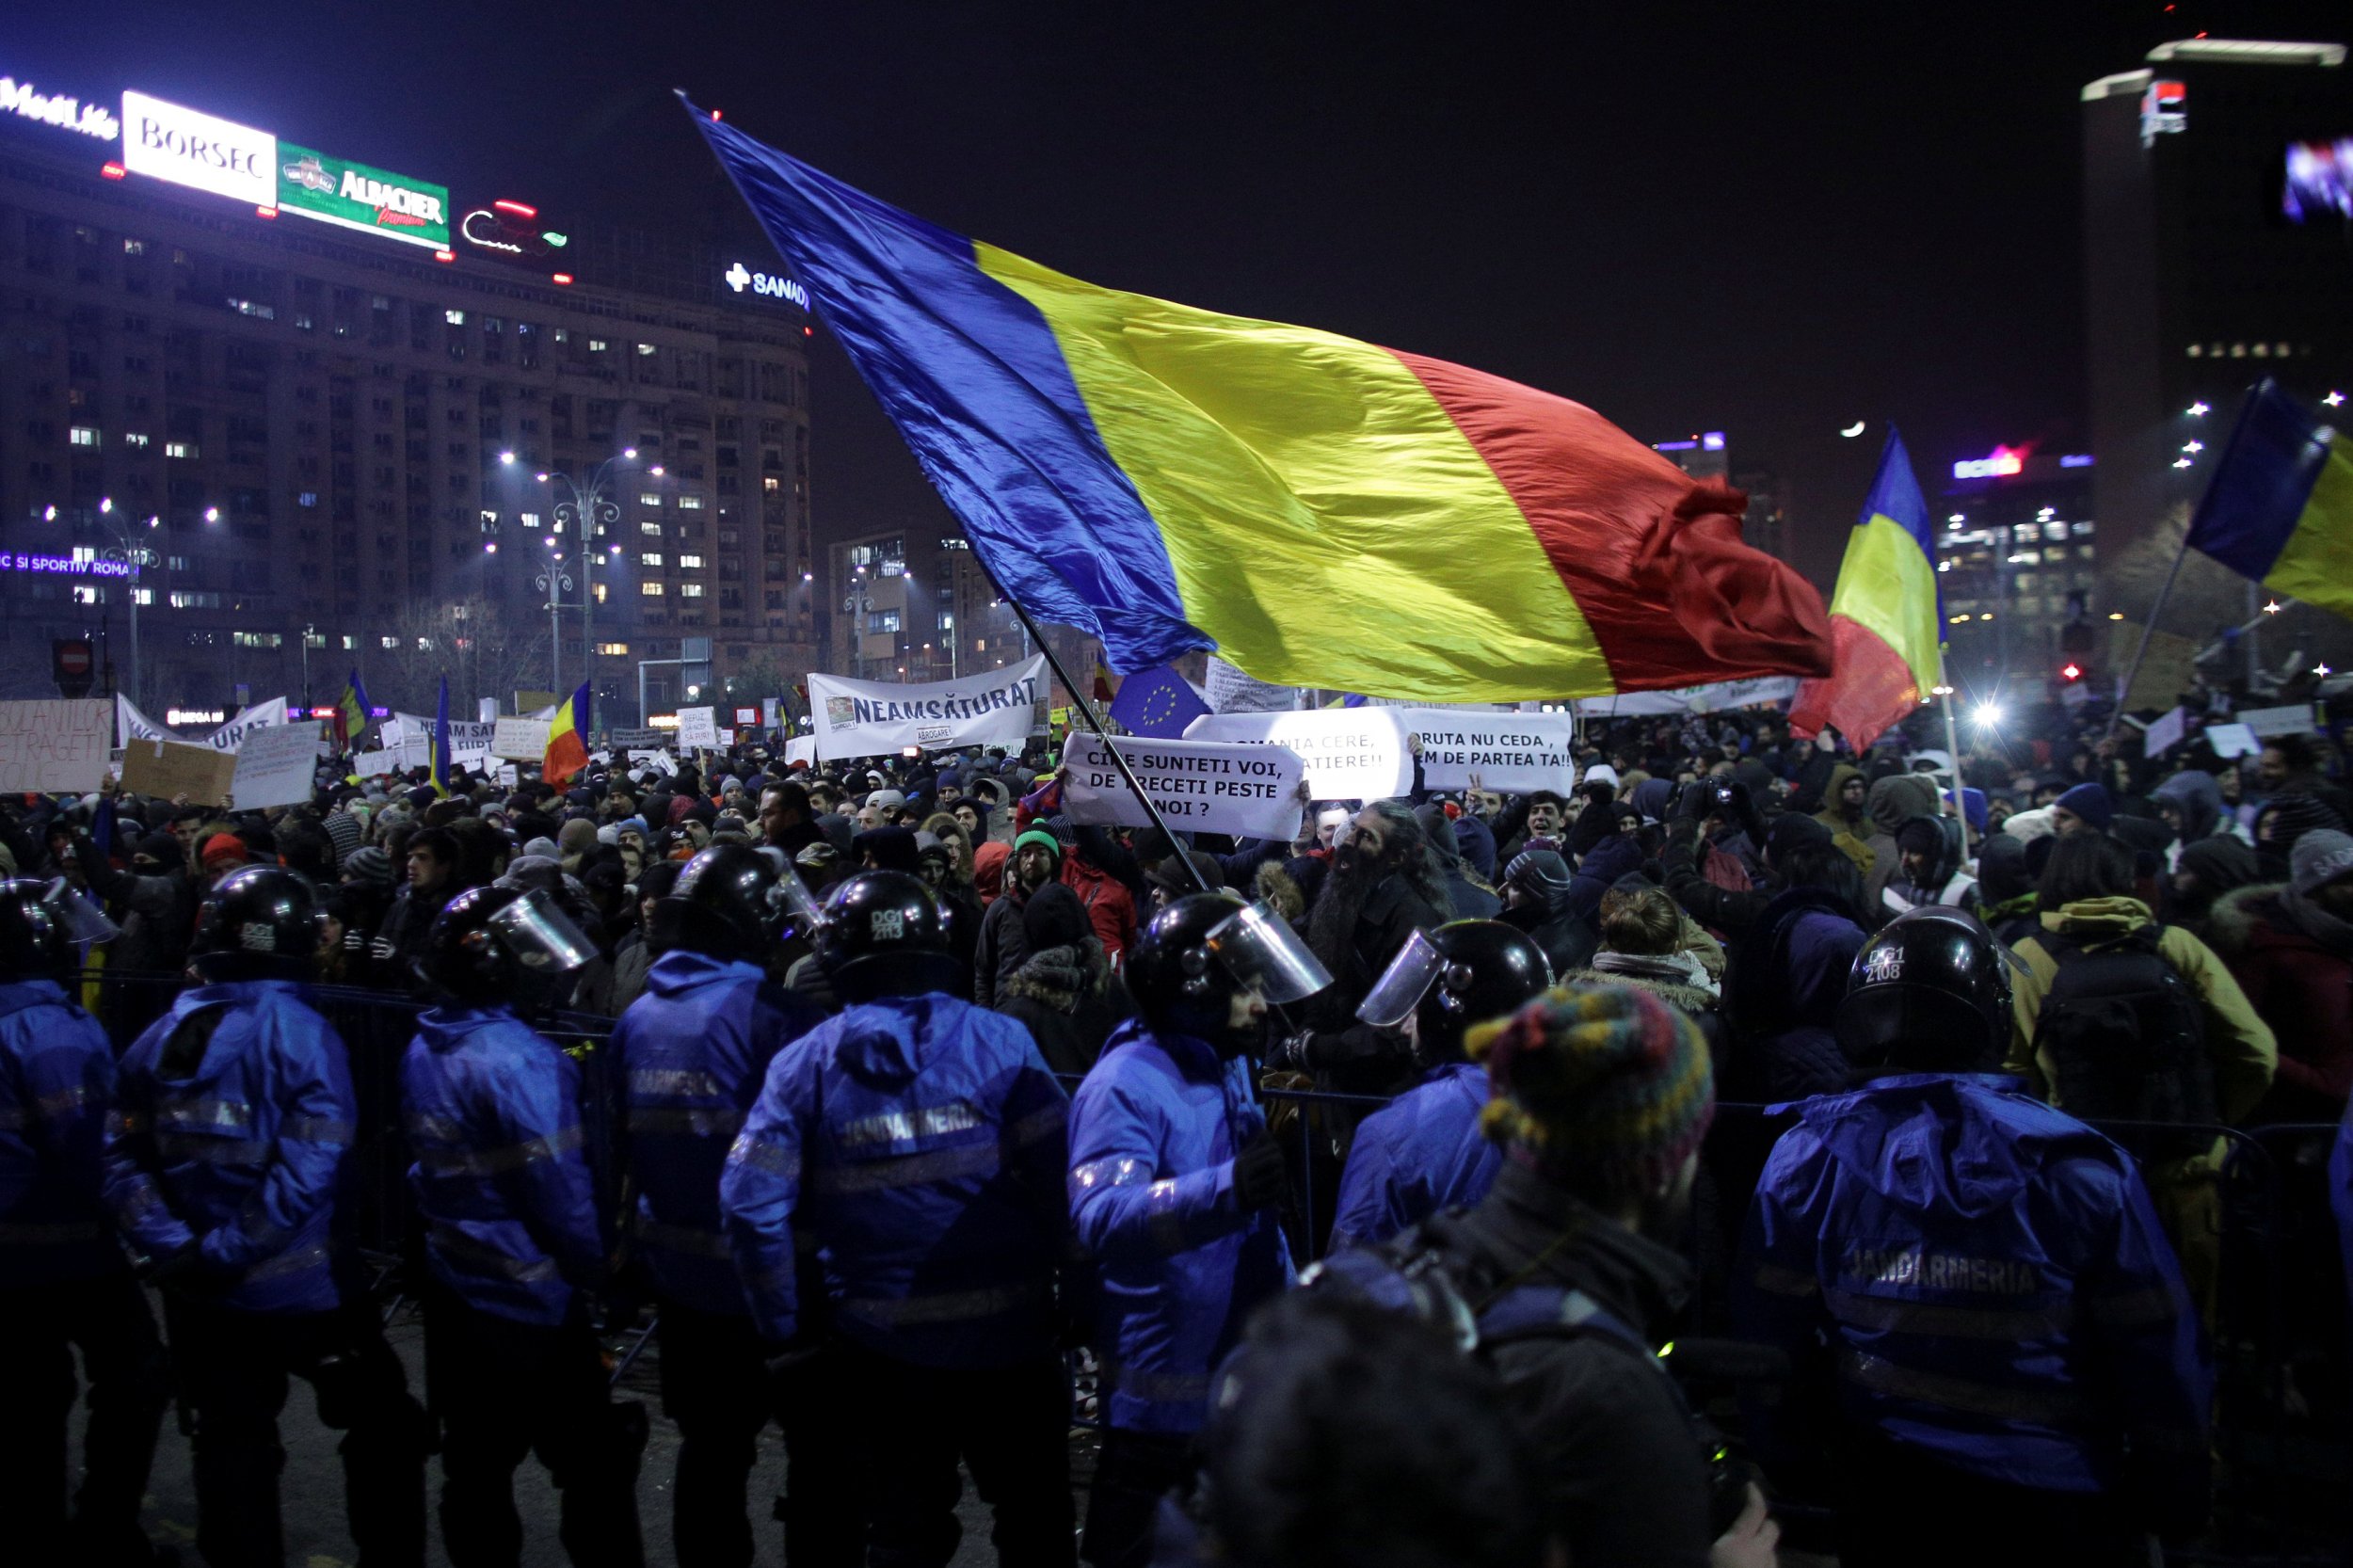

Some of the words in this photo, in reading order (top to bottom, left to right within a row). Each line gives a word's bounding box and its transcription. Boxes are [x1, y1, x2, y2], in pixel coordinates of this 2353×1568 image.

[141, 117, 264, 179] BORSEC
[340, 170, 444, 225] ALBACHER
[32, 559, 89, 572] SPORTIV
[1471, 734, 1495, 746] NU
[1500, 734, 1544, 747] CEDA
[1087, 752, 1135, 768] CIE
[1143, 755, 1231, 775] SUNTETI
[1238, 760, 1283, 780] VOI,
[1444, 752, 1465, 765] DE
[1471, 753, 1532, 766] PARTEA
[1537, 754, 1571, 767] TA!!
[1090, 773, 1116, 789] DE
[1214, 782, 1278, 799] PESTE
[1154, 800, 1193, 816] NOI
[1865, 964, 1901, 984] 2108
